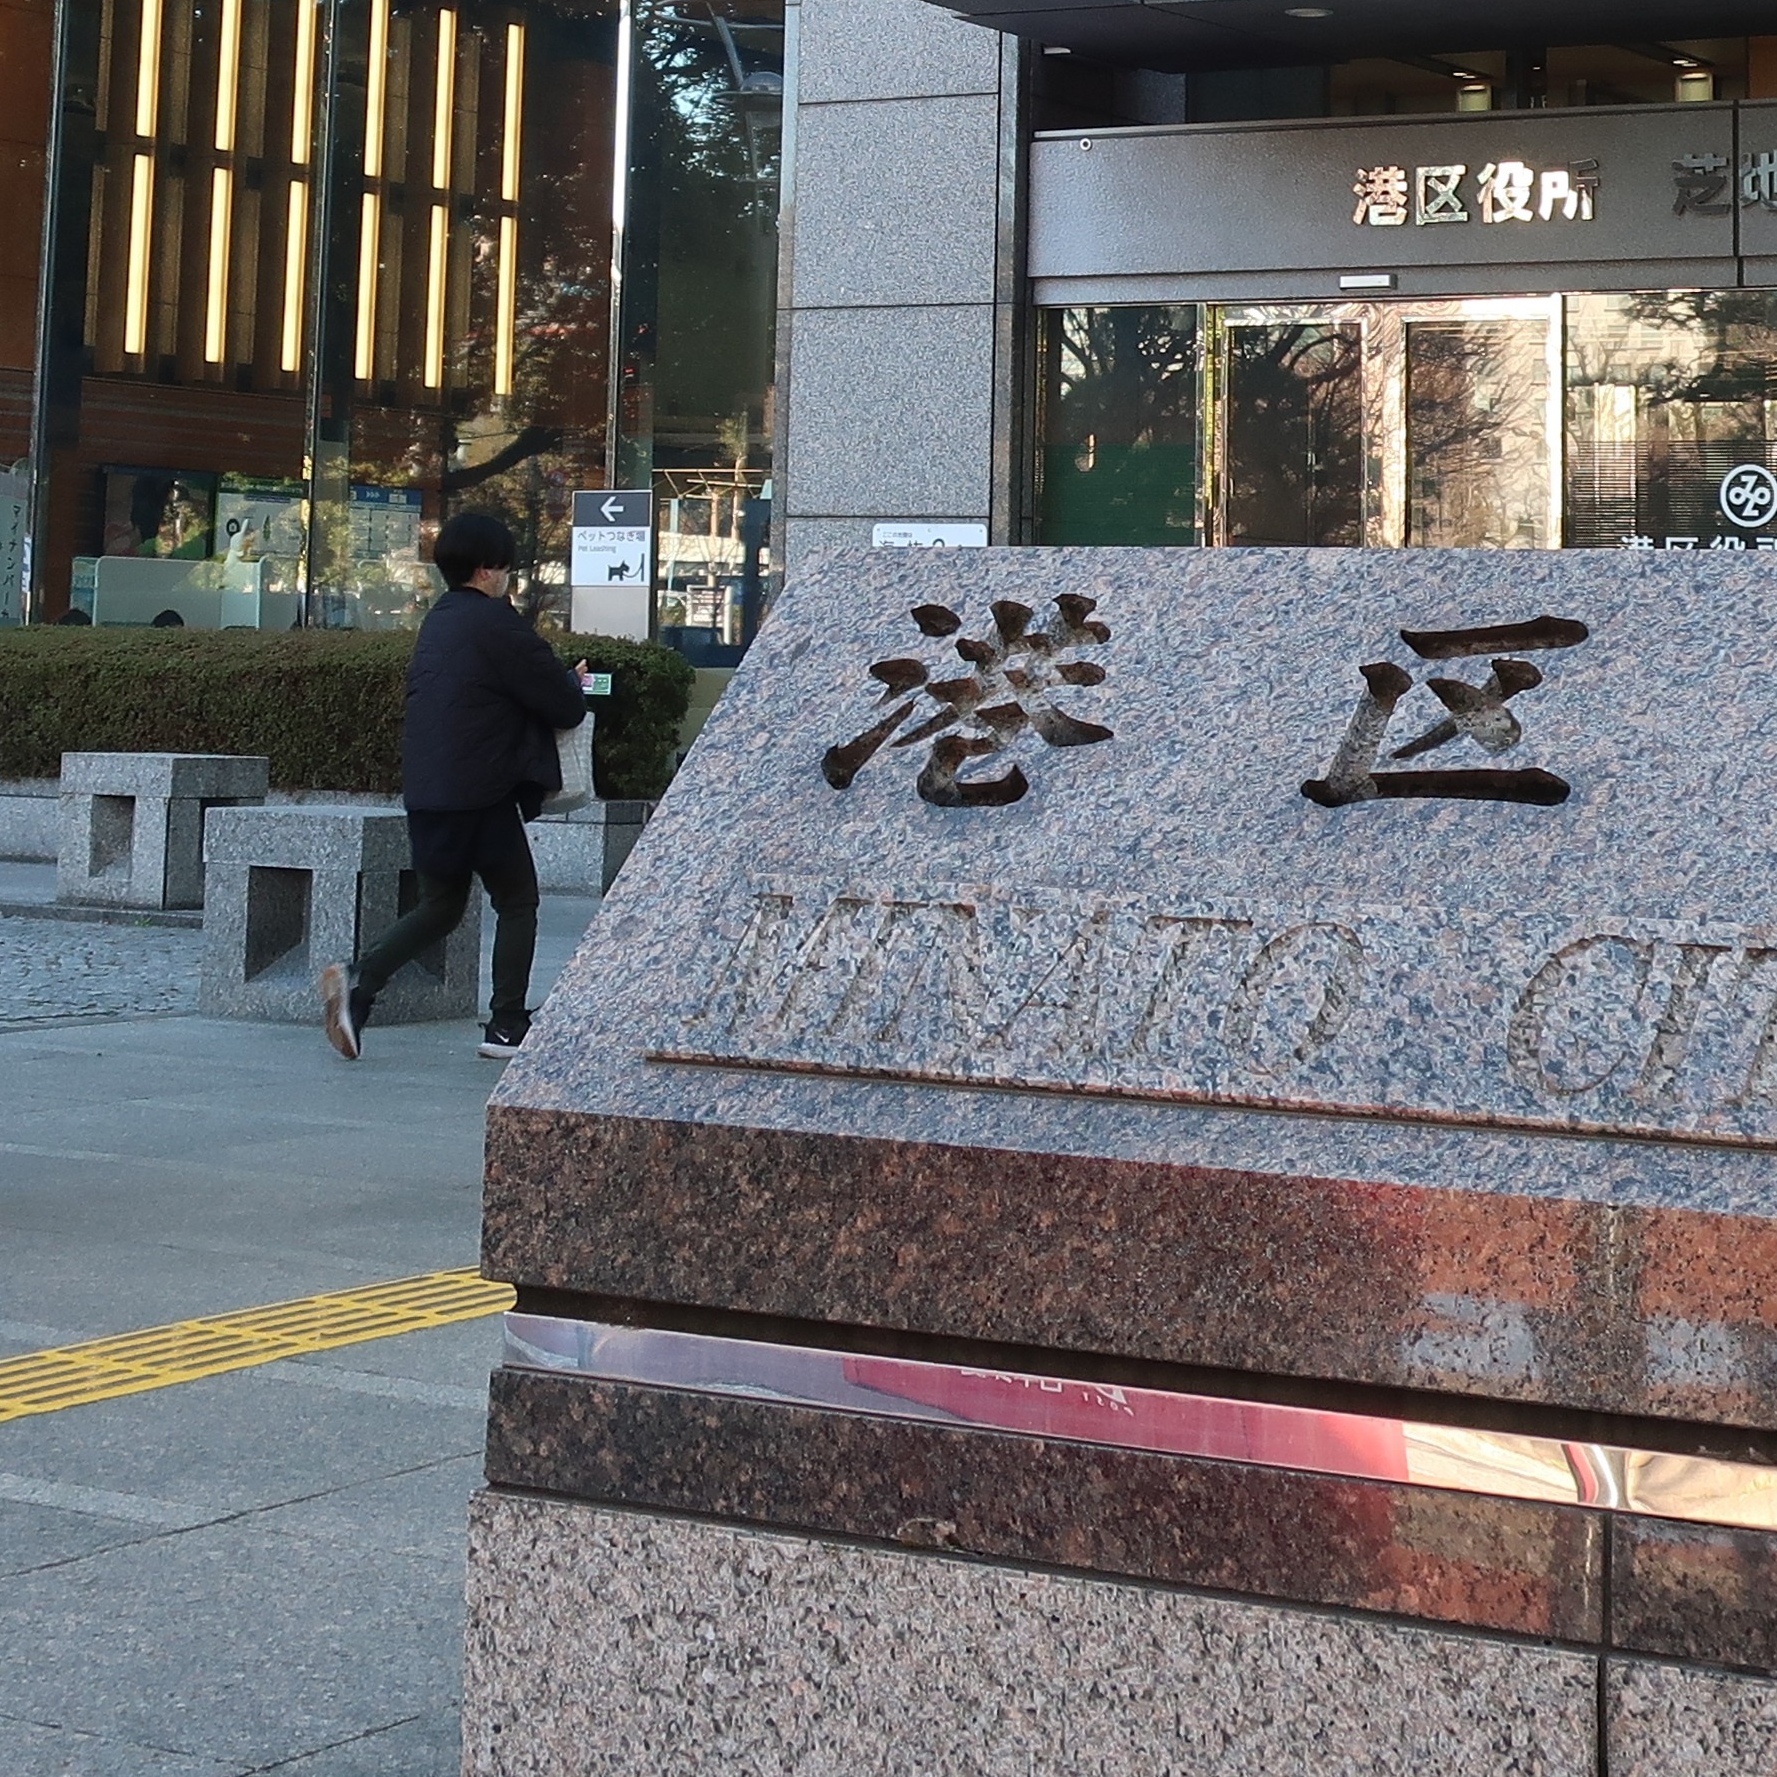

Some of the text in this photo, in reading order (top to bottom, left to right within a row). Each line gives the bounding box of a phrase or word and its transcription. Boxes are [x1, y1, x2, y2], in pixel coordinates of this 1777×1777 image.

[1352, 157, 1599, 226] 港区役所
[683, 890, 1366, 1076] MINATO
